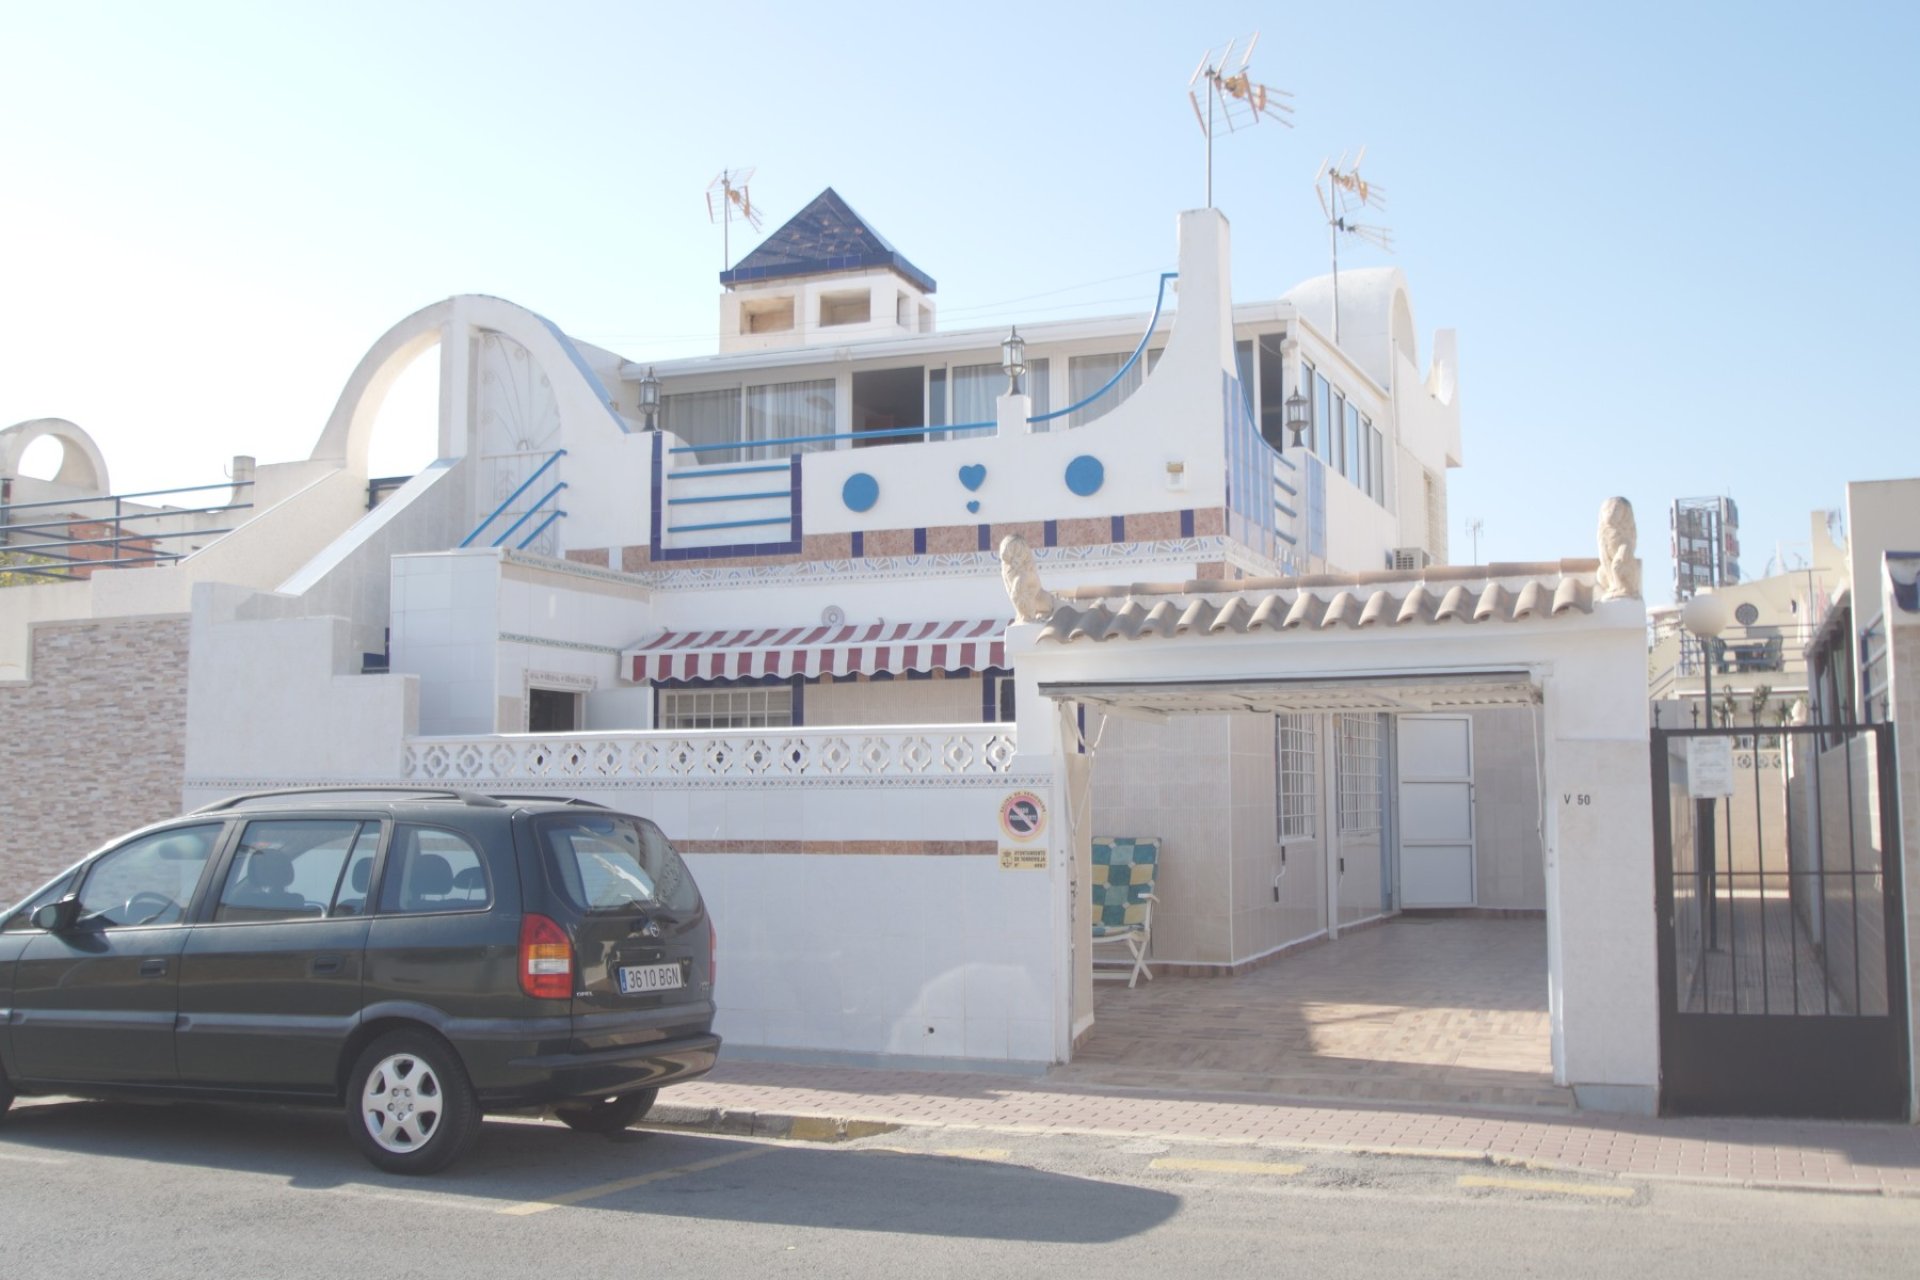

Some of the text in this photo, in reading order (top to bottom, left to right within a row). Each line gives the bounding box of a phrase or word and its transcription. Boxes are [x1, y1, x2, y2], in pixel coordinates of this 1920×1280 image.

[1563, 793, 1591, 806] V 50
[628, 968, 657, 989] 3610
[659, 966, 680, 987] BGN
